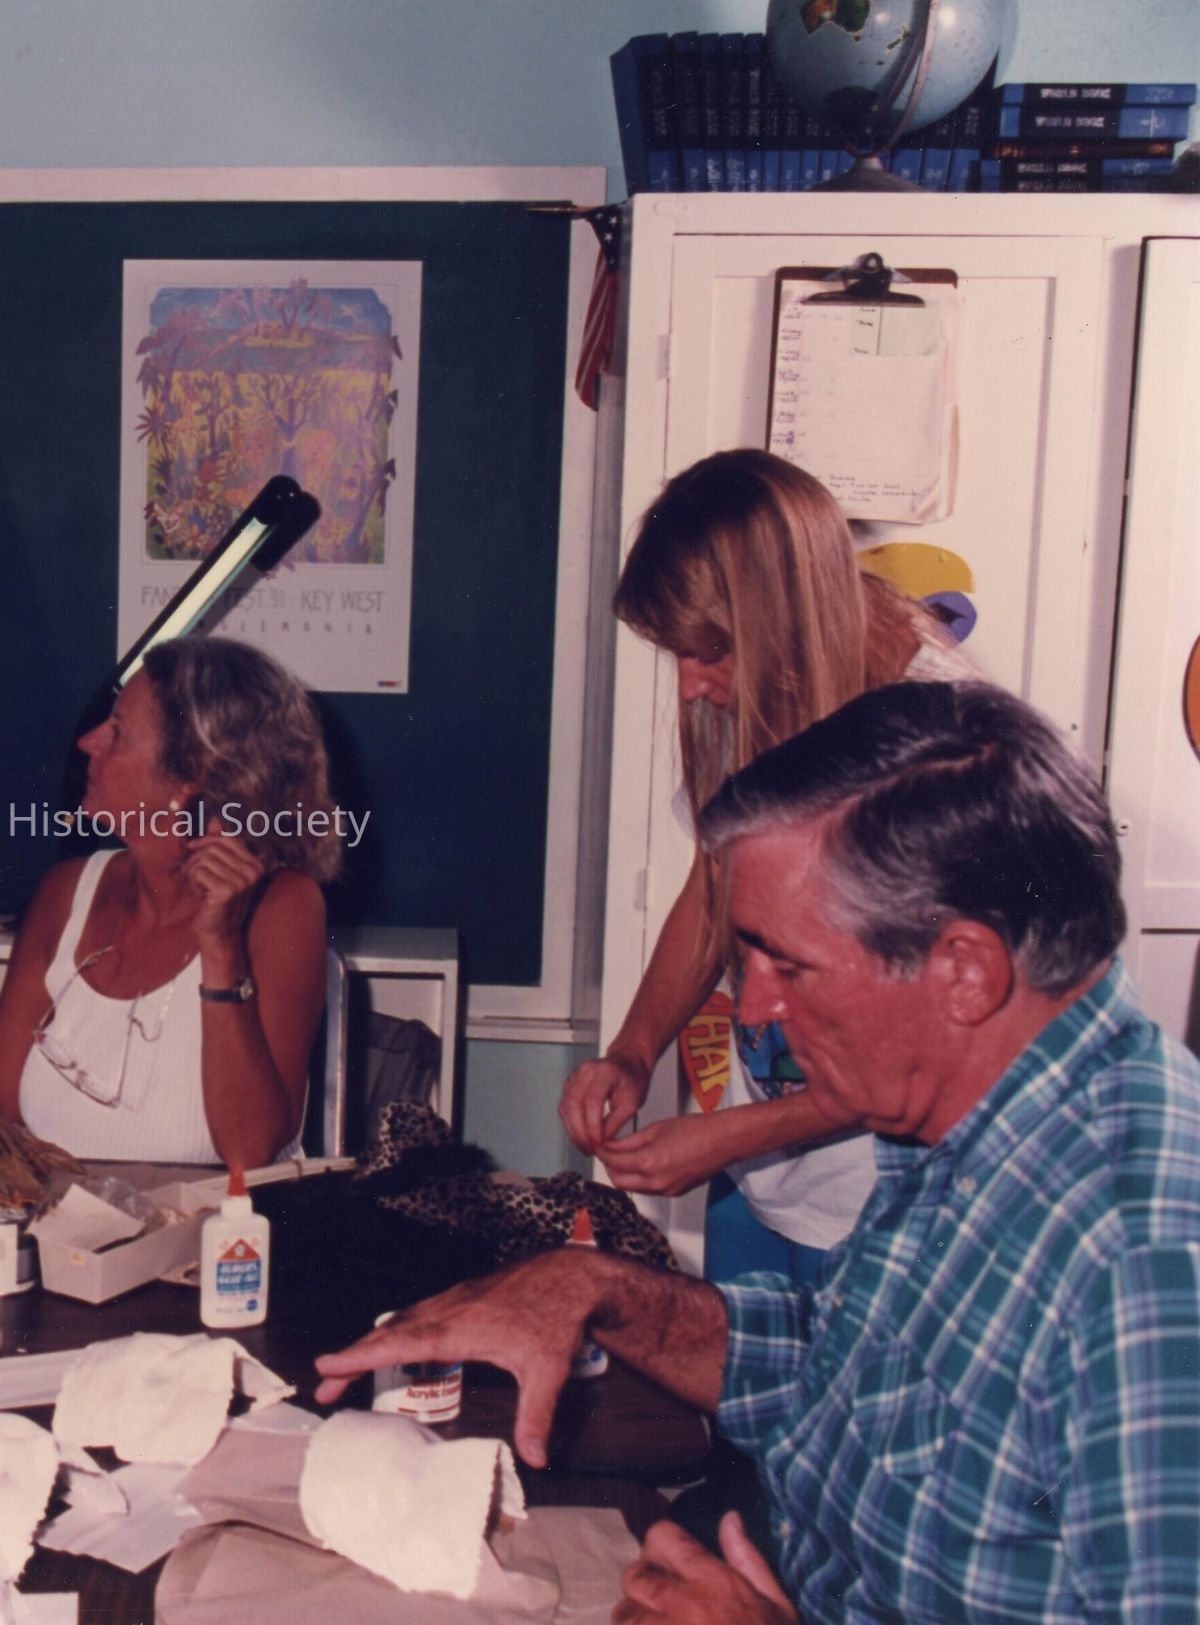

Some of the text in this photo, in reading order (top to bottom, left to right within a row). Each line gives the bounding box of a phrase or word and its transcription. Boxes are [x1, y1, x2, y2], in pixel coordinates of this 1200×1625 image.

[301, 590, 332, 613] KEY
[341, 590, 387, 614] WEST
[406, 1387, 441, 1400] Acrylic
